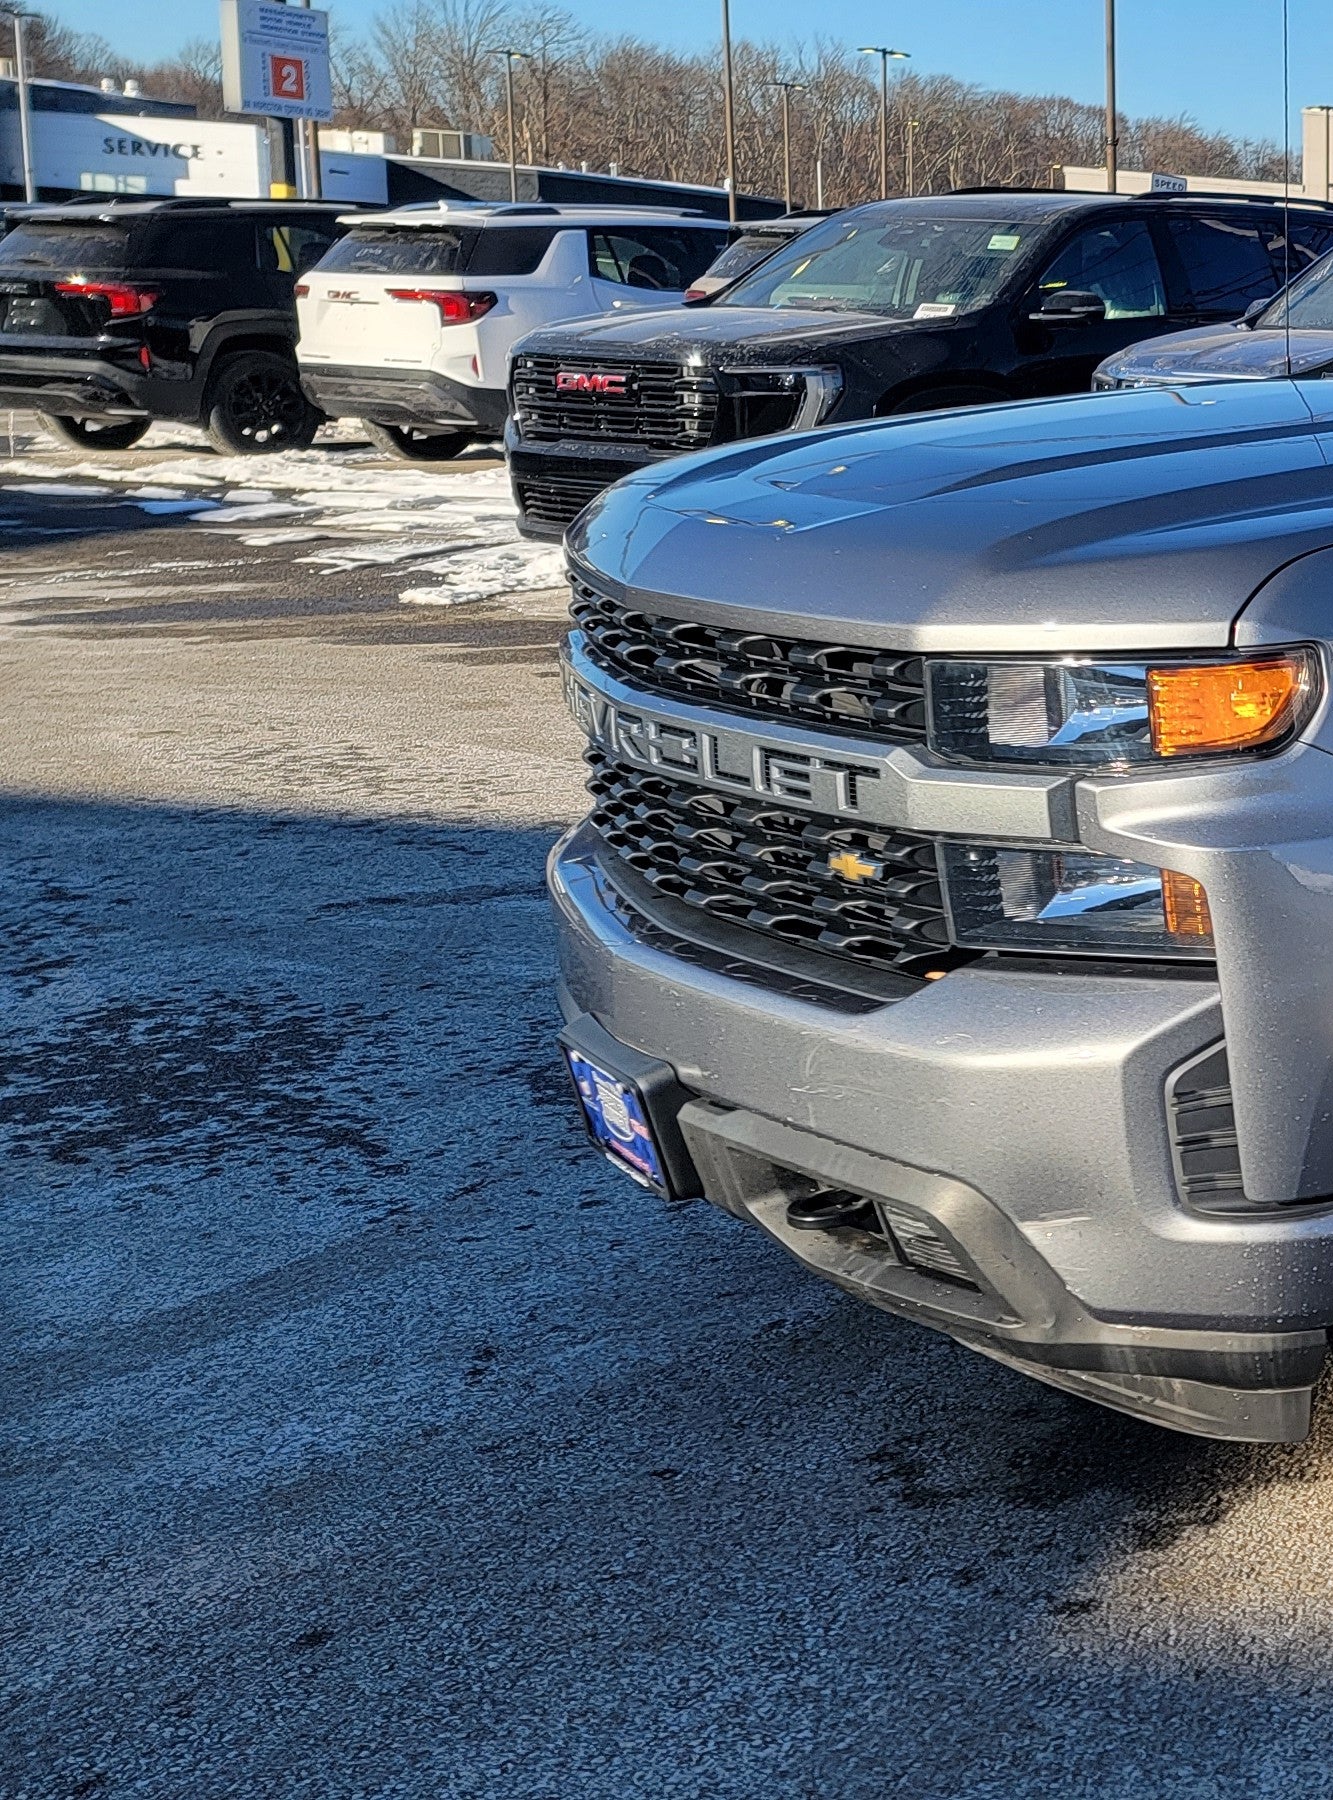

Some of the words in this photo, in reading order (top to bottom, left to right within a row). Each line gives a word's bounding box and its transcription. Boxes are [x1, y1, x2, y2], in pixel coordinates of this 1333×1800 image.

[281, 64, 298, 92] 2
[102, 137, 205, 160] SERVICE
[1155, 179, 1184, 191] SPEED
[556, 372, 628, 394] GMC
